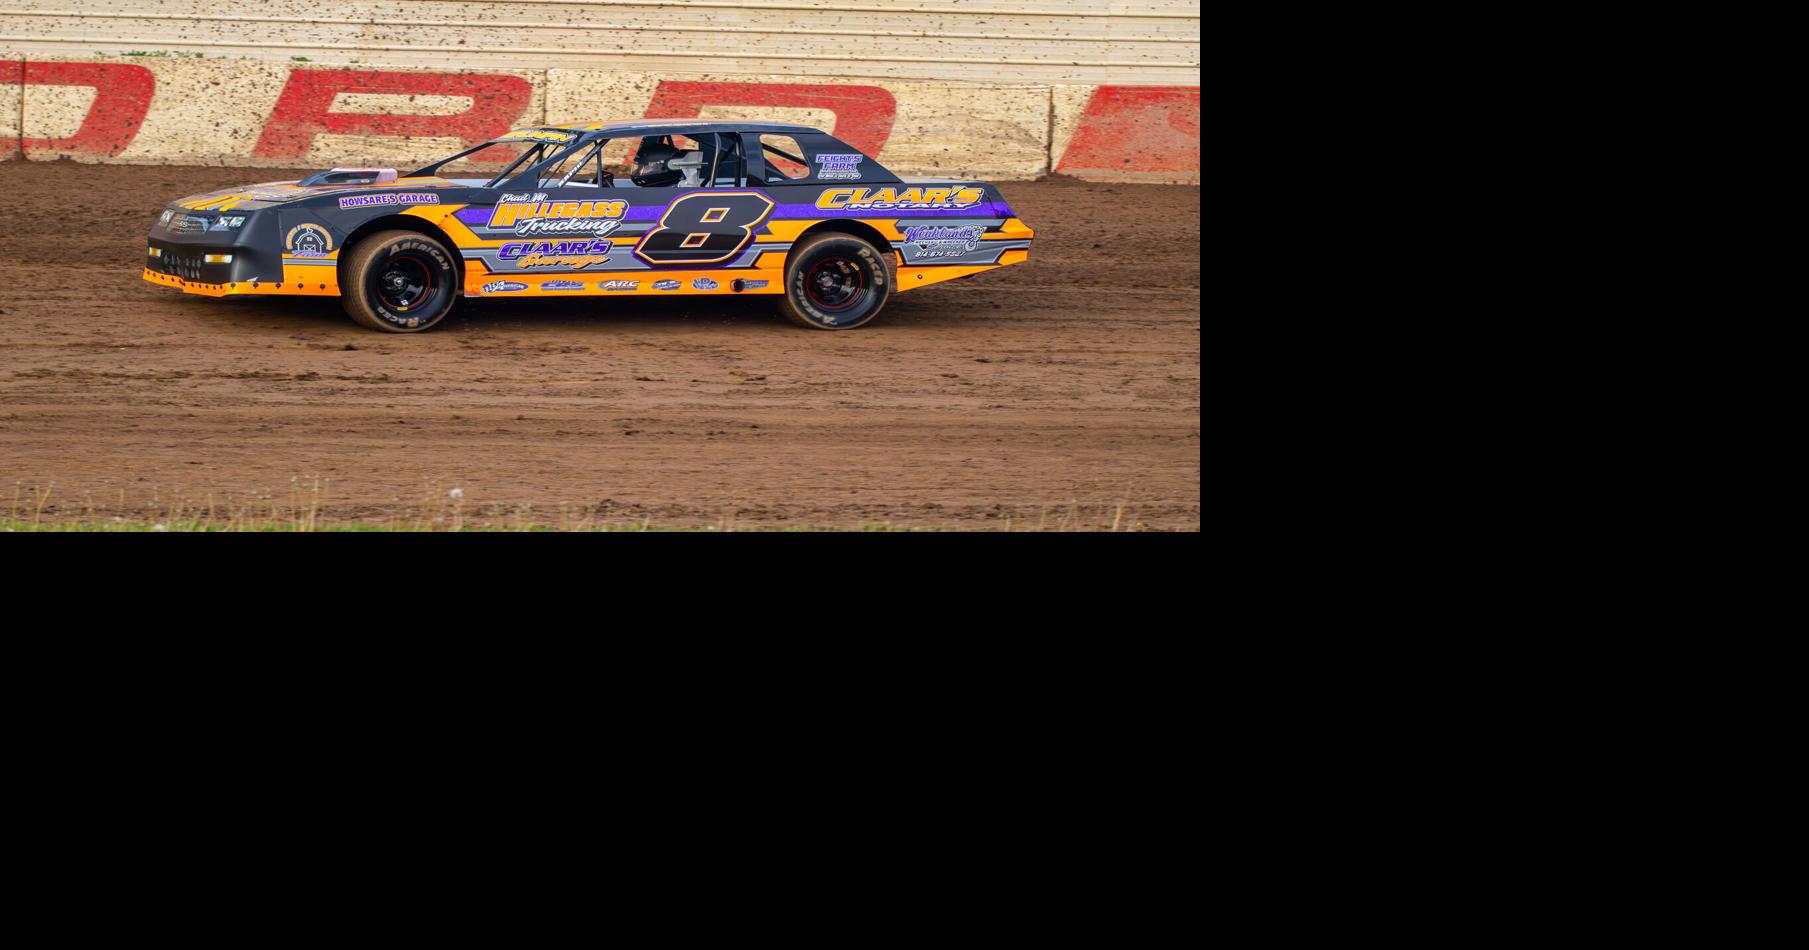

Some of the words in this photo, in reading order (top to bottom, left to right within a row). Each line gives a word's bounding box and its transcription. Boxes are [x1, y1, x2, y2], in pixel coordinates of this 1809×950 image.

[822, 162, 857, 170] FARM
[340, 195, 396, 207] HOWSARE'S
[399, 194, 437, 203] GARAGE
[816, 186, 984, 210] CLAAR'S
[849, 202, 971, 210] NOTARY
[490, 201, 627, 227] HILLEGASS
[518, 216, 620, 235] Trucking
[635, 192, 775, 264] 8
[499, 239, 612, 258] CLAAR'S
[518, 253, 609, 269] Garage
